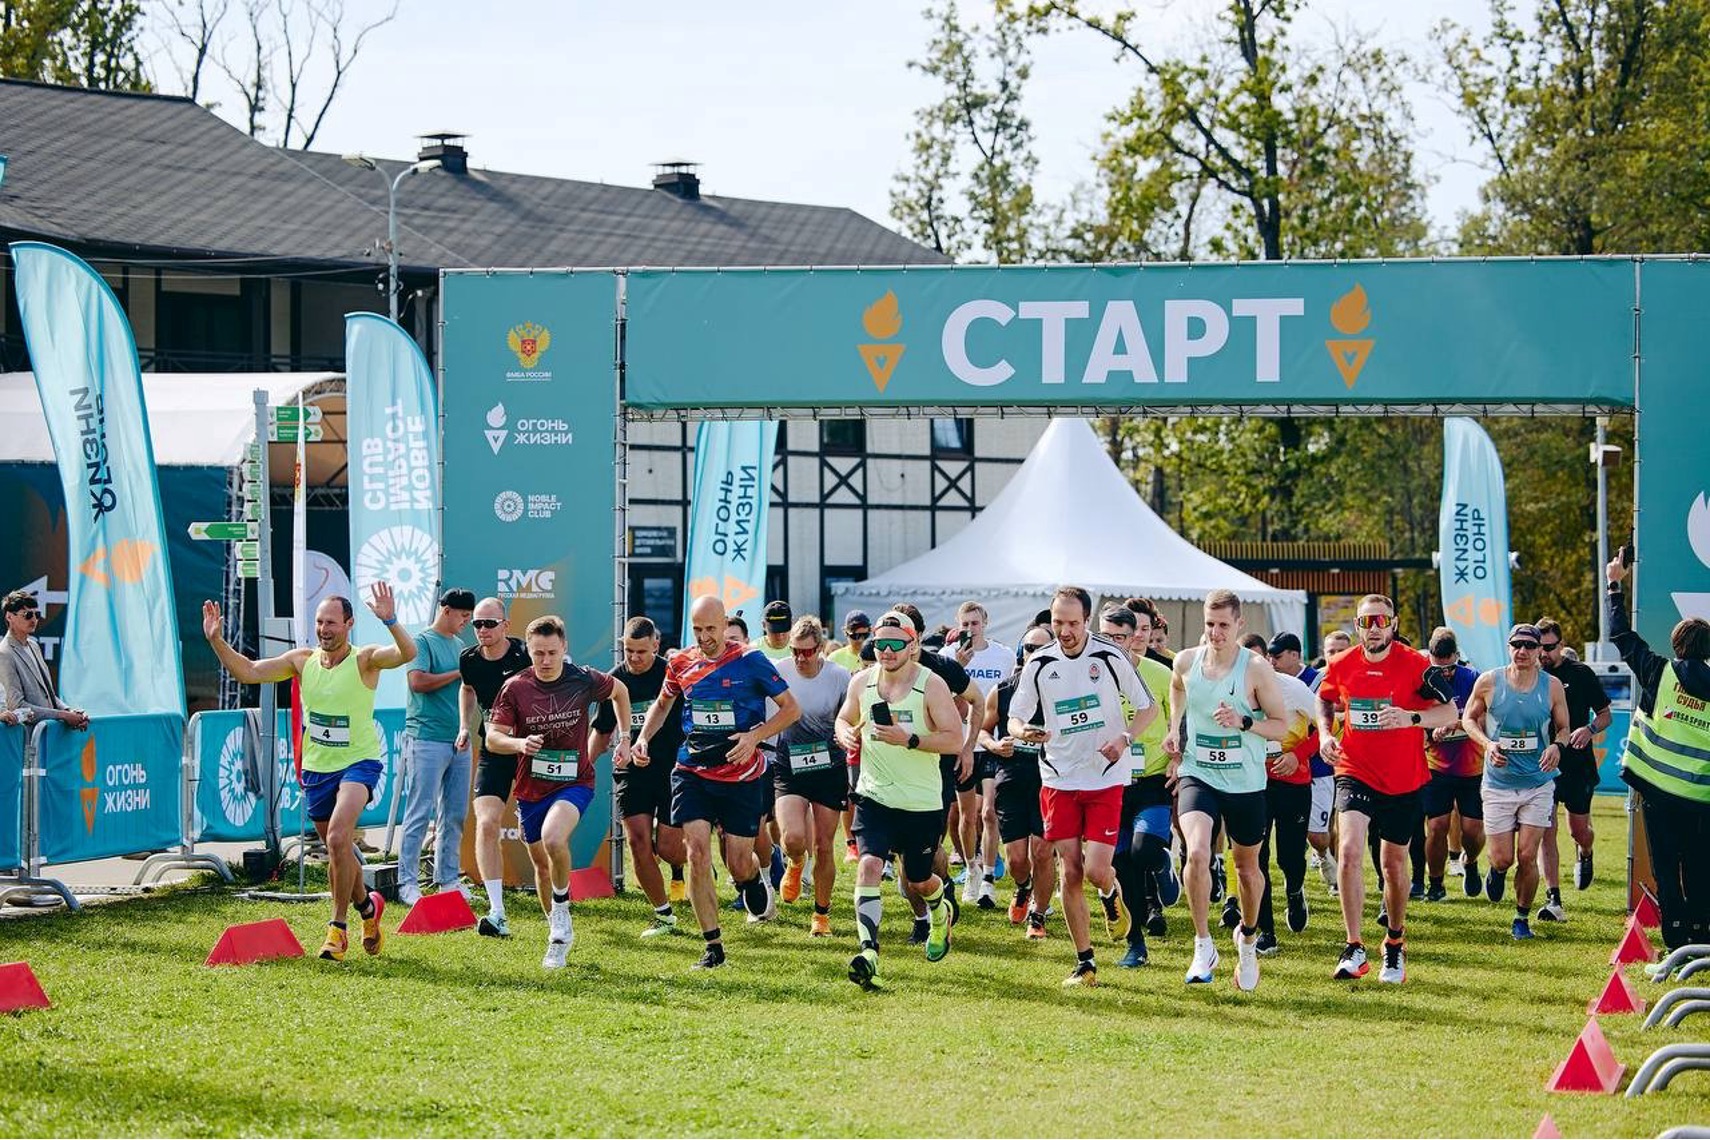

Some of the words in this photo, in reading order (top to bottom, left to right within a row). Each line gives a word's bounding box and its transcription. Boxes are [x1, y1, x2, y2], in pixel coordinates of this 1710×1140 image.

[941, 298, 1305, 387] СТАРТ
[517, 419, 569, 431] ОГОНЬ
[513, 433, 573, 444] ЖИЗНИ
[528, 494, 557, 503] NOBLE
[528, 502, 562, 510] IMPACT
[528, 510, 551, 518] CLUB
[712, 470, 734, 556] ОГОНЬ
[732, 465, 757, 562] ЖИЗНИ
[497, 569, 555, 592] RMG
[1676, 694, 1707, 712] СУДЬЯ
[525, 715, 547, 724] БЕГУ
[548, 710, 580, 721] ВМЕСТЕ
[705, 714, 720, 724] 13
[1070, 712, 1088, 725] 59
[1362, 713, 1378, 723] 39
[322, 729, 331, 739] 4
[1511, 740, 1525, 748] 28
[803, 755, 817, 765] 14
[1209, 751, 1226, 762] 58
[106, 763, 147, 786] ОГОНЬ
[547, 763, 562, 775] 51
[104, 788, 150, 814] ЖИЗНИ
[1321, 811, 1329, 827] 9
